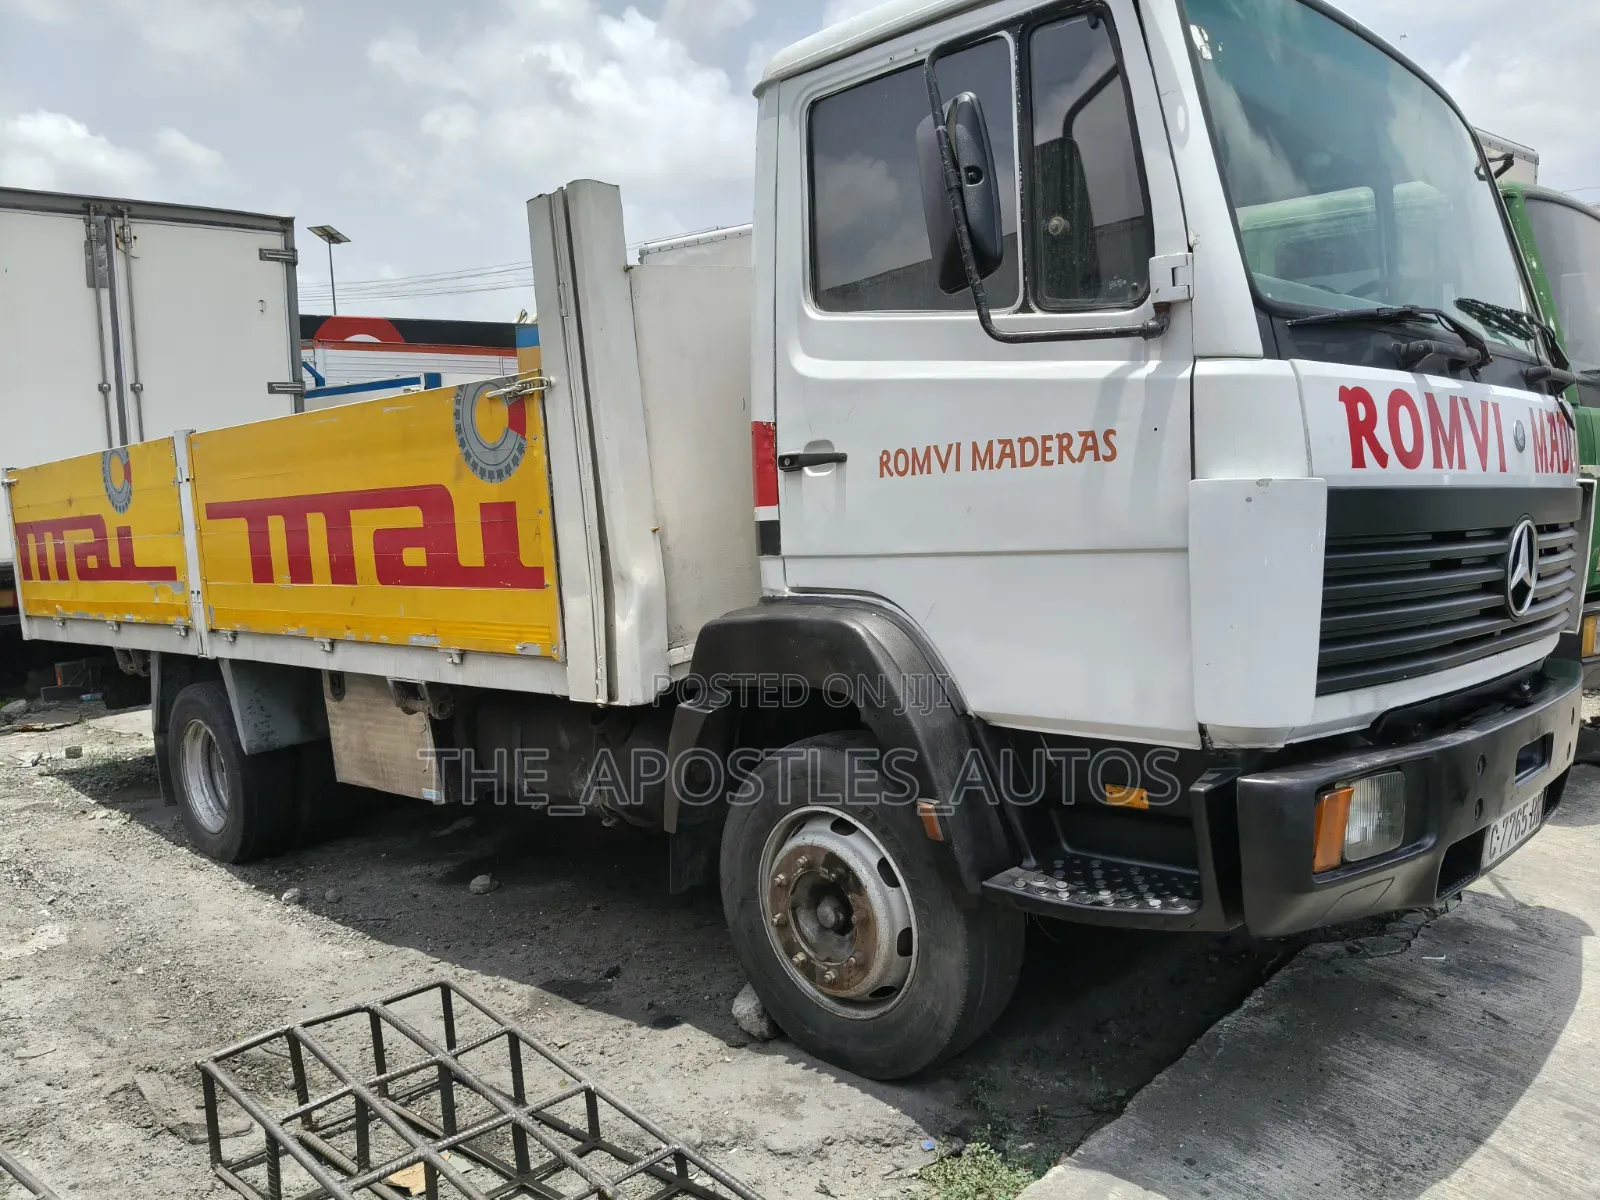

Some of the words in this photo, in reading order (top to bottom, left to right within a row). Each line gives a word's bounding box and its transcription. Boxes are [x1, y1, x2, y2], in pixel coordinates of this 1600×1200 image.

[879, 441, 961, 478] ROMVI
[970, 428, 1117, 472] MADERAS
[1338, 385, 1507, 473] ROMVI
